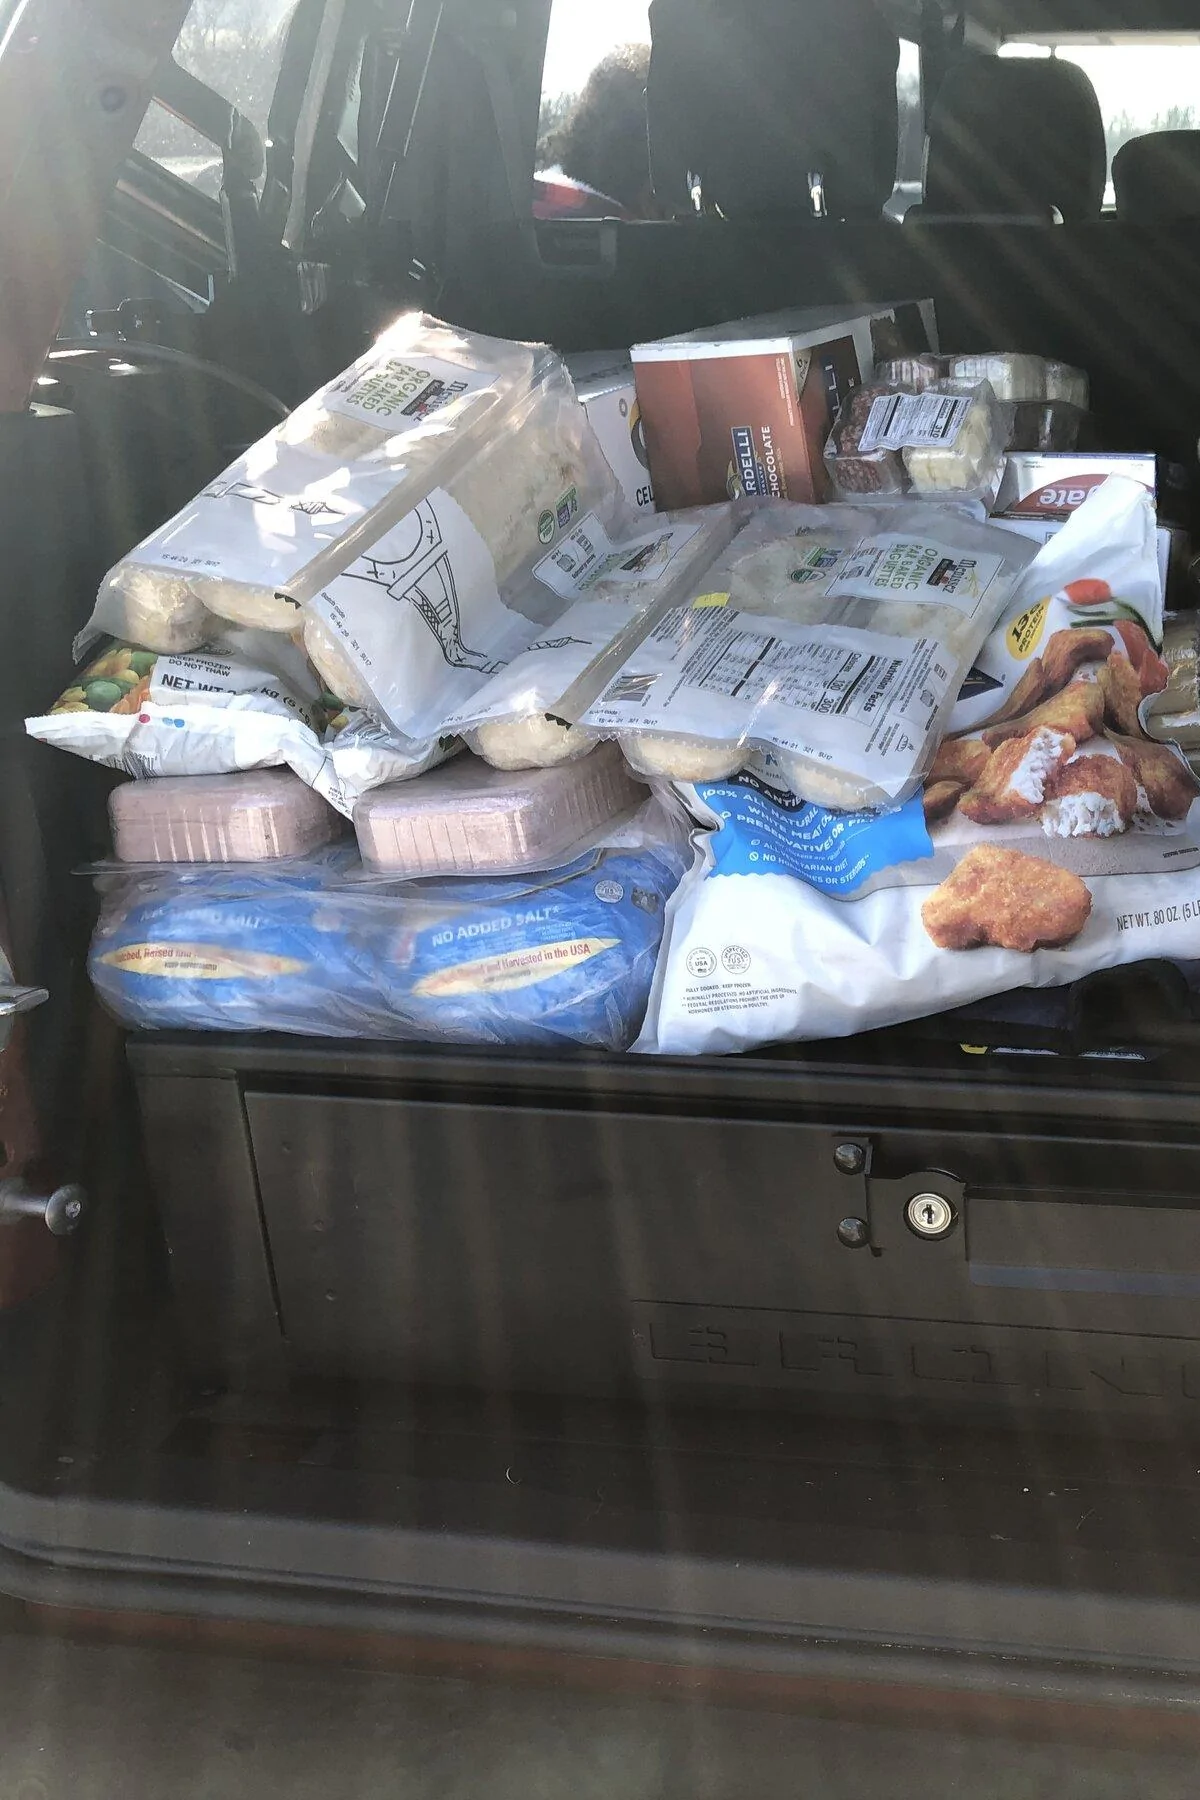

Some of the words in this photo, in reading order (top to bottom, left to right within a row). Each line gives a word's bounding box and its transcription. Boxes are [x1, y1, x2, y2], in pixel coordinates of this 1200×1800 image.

[362, 382, 396, 410] BAKED
[376, 370, 431, 417] ORGANIC
[932, 425, 943, 438] 310
[737, 429, 758, 496] RDELLI
[890, 560, 912, 589] BAKED
[905, 549, 938, 591] ORGANIC
[169, 659, 182, 667] DO
[184, 663, 202, 671] NOT
[205, 667, 230, 677] THAW
[196, 659, 231, 671] FROZEN
[877, 660, 903, 690] Nutrition
[162, 674, 194, 690] NET
[818, 698, 834, 713] 300
[863, 691, 883, 713] Facts
[739, 775, 760, 788] NO
[743, 793, 768, 809] ALL
[772, 806, 819, 829] NATURAL
[748, 806, 786, 834] WHITE
[791, 825, 824, 840] MEAT
[737, 815, 835, 853] PRESERVATIVES
[832, 824, 845, 839] OR
[763, 853, 776, 862] NO
[825, 876, 838, 885] OR
[834, 858, 849, 873] DIET
[432, 930, 454, 947] NO
[457, 915, 513, 941] ADDED
[1117, 914, 1135, 931] NET
[1135, 912, 1152, 928] WT.
[1153, 909, 1165, 925] 80
[1166, 906, 1181, 923] OZ.
[1182, 903, 1191, 921] (5
[502, 951, 543, 969] Harvested
[544, 950, 554, 961] in
[554, 946, 569, 959] the
[570, 943, 591, 958] USA
